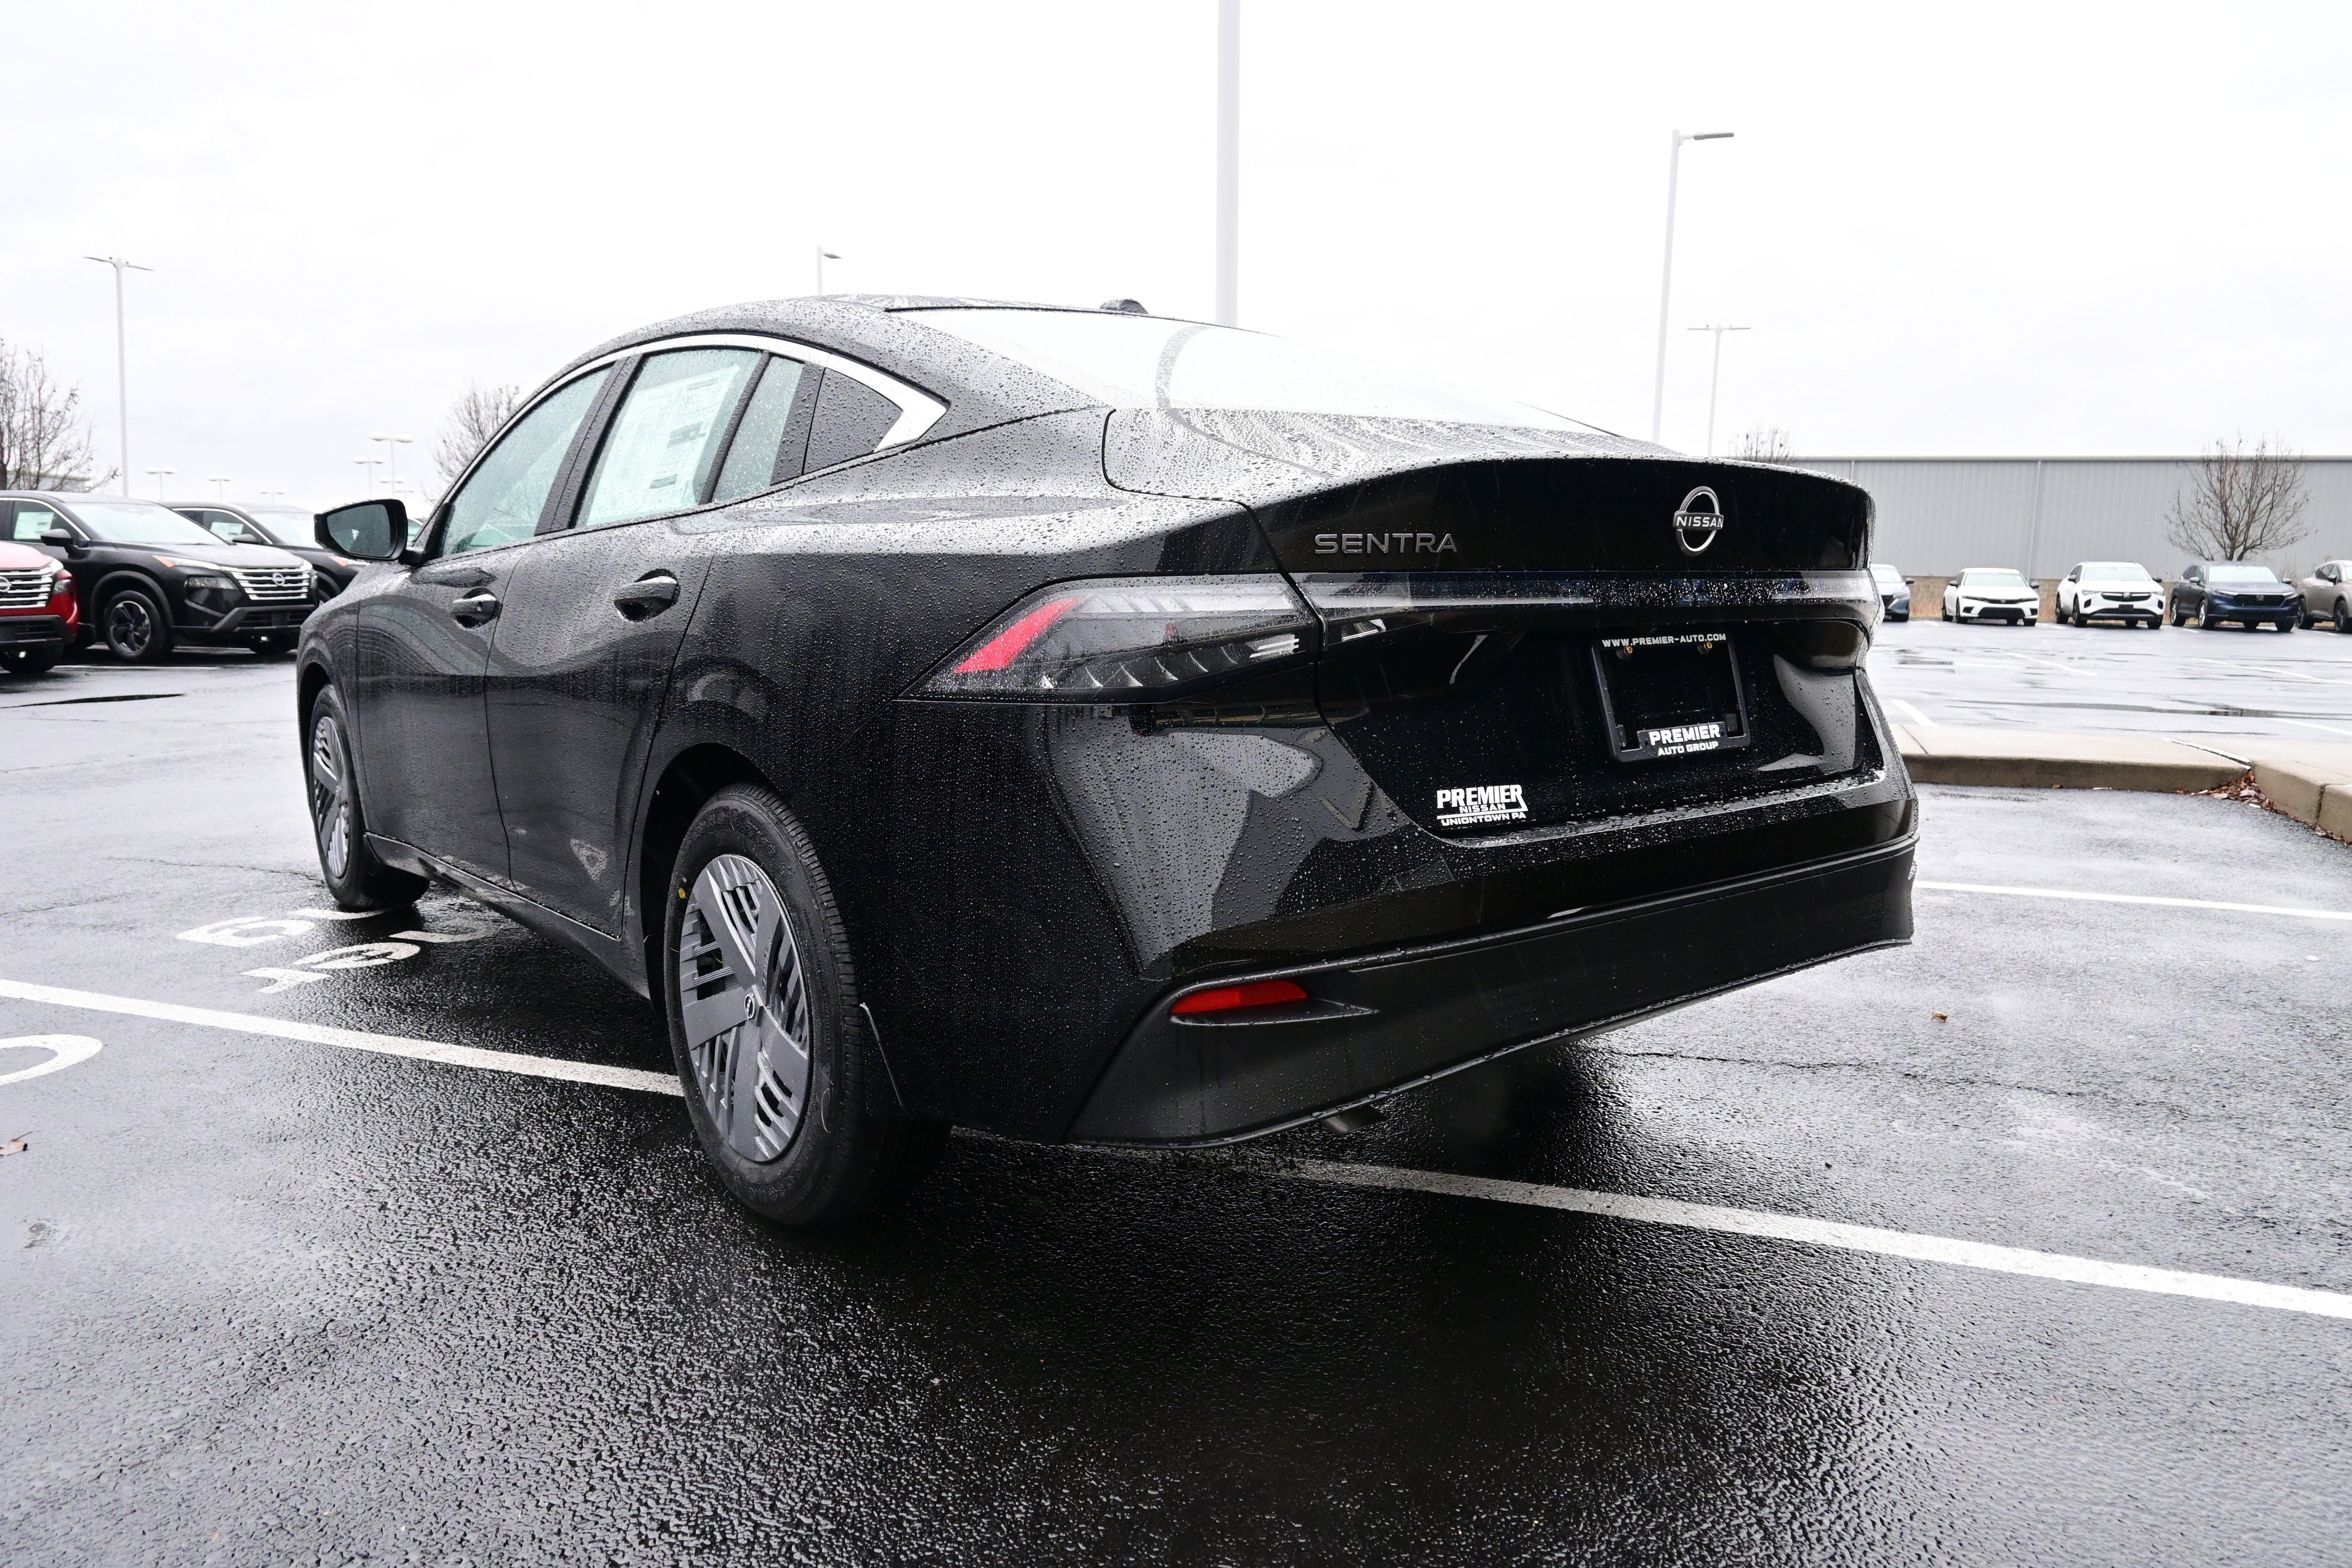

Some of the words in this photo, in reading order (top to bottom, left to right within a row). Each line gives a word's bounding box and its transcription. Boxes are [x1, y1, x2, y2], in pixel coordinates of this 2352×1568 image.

[1676, 516, 1723, 528] NISSAN
[1315, 533, 1457, 554] SENTRA
[1602, 633, 1726, 647] WWW.PREMIER-AUTO.COM
[1649, 724, 1721, 746] PREMIER
[1658, 745, 1685, 757] AUTO
[1686, 741, 1718, 752] GROUP
[1437, 784, 1523, 808] PREMIER
[1459, 803, 1506, 813] NISSAN
[1441, 813, 1510, 826] UNIONTOWN
